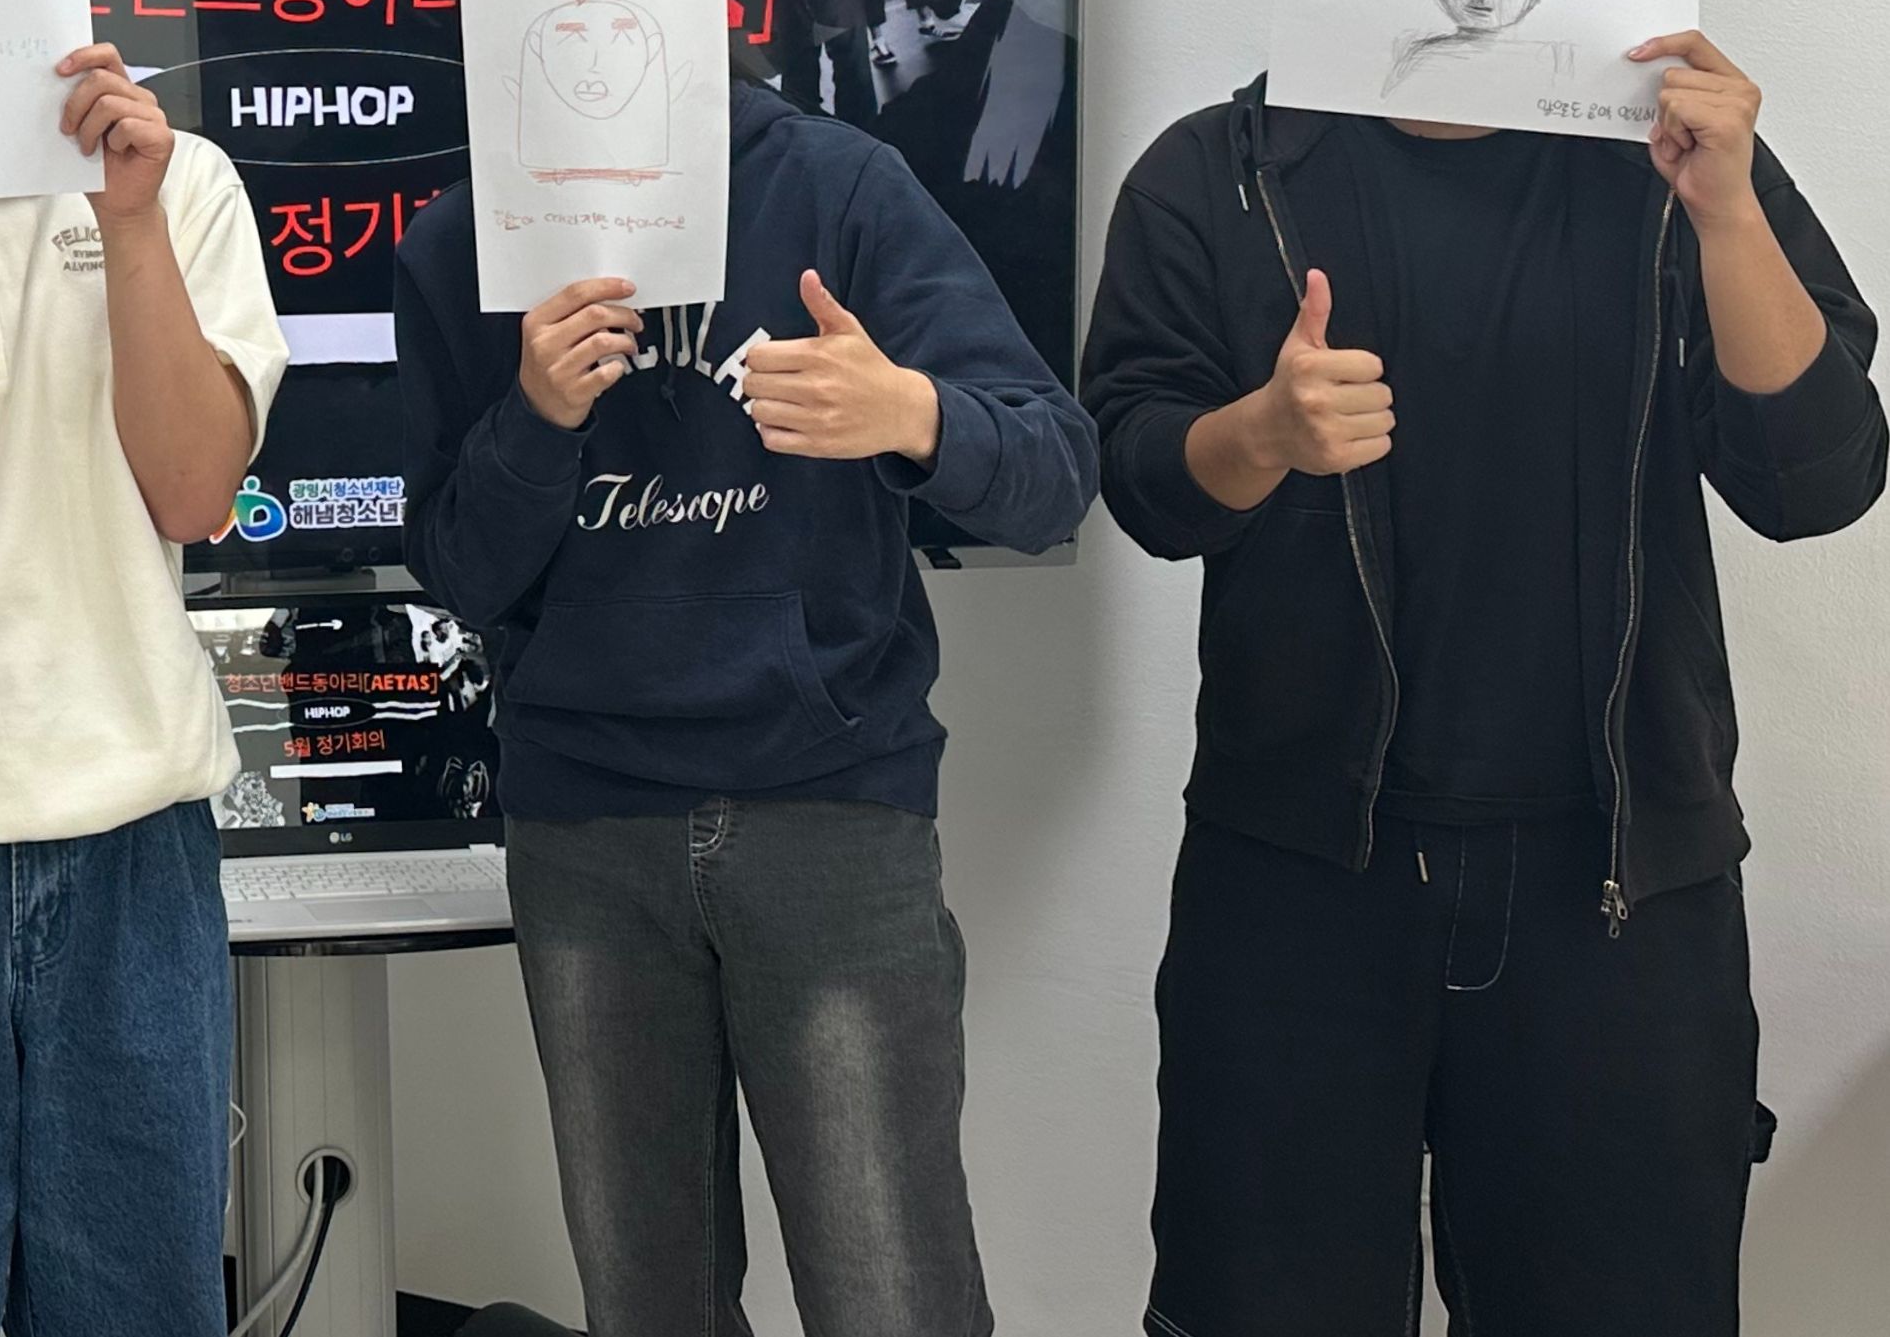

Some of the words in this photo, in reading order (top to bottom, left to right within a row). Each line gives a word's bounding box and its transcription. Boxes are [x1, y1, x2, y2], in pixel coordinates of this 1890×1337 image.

[230, 84, 415, 127] HIPHOP
[270, 189, 441, 276] 정기
[292, 480, 402, 499] 광명시청소년재단
[576, 473, 771, 534] Telescope
[292, 500, 406, 527] 해냄청소년
[304, 706, 351, 720] HIPHOP
[283, 737, 312, 758] 5월
[316, 729, 386, 757] 정기회의
